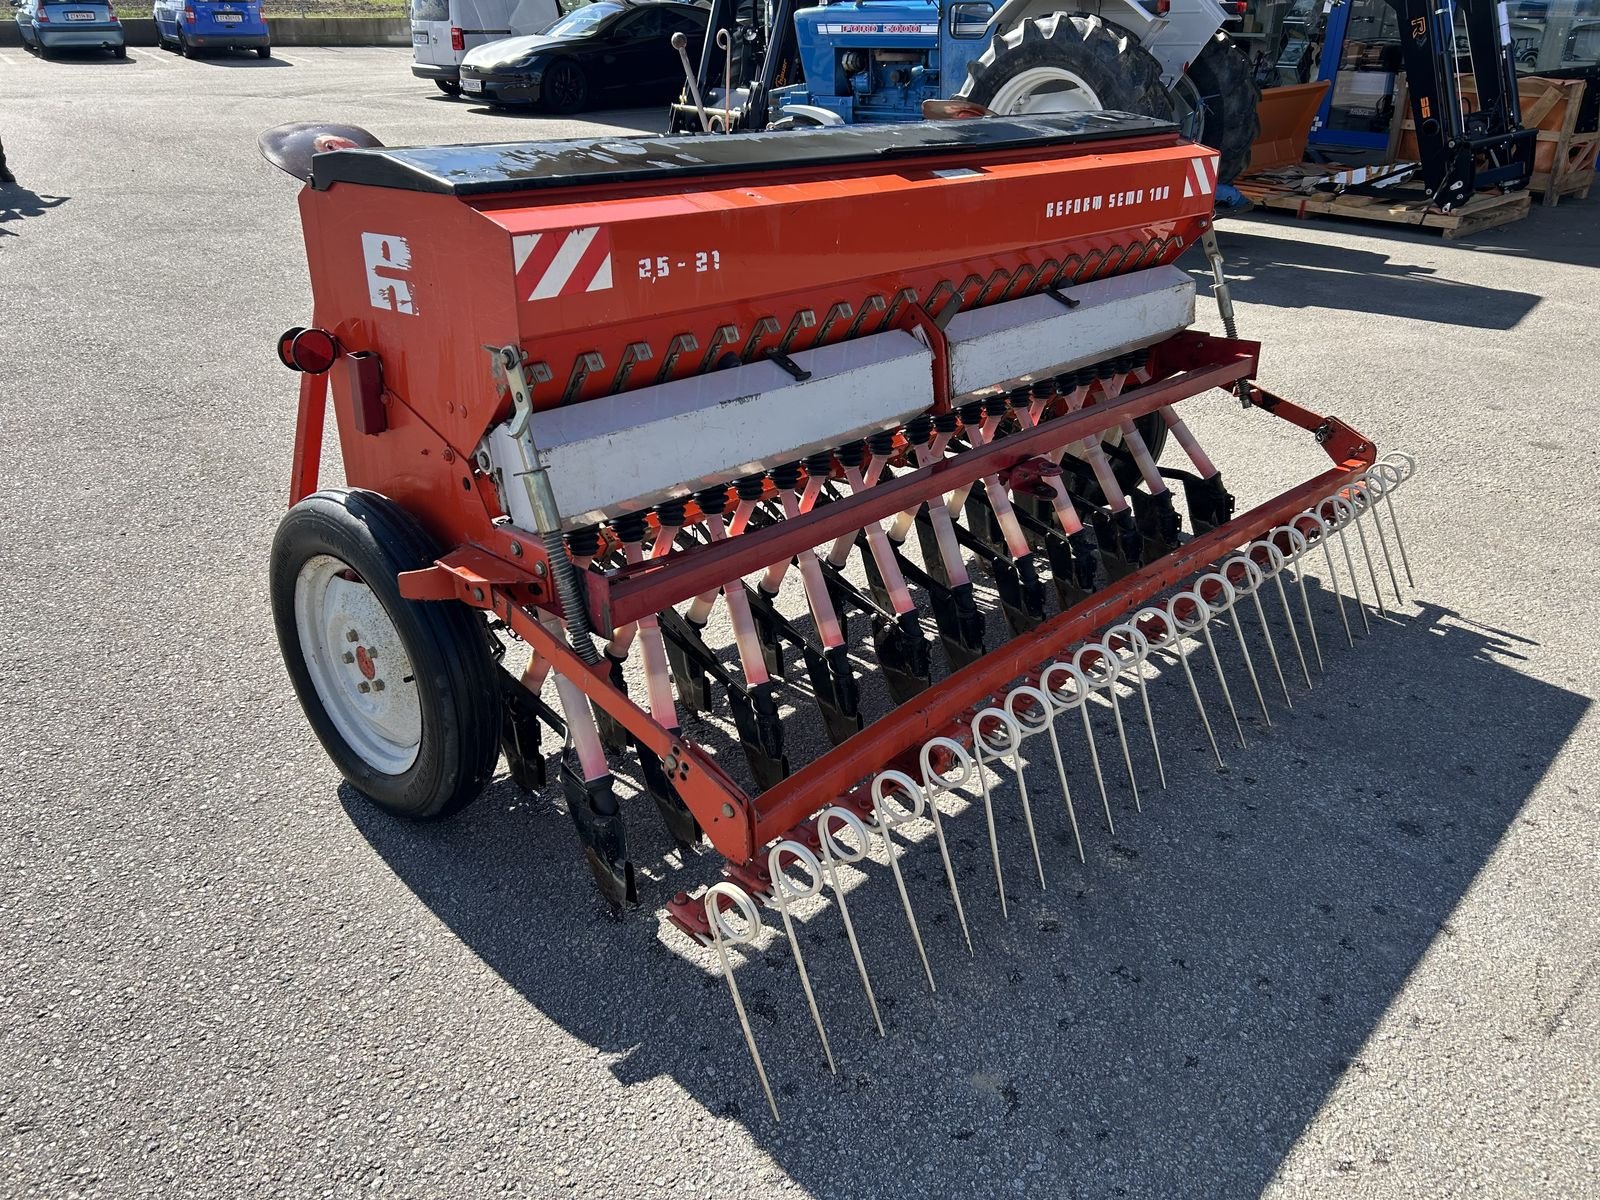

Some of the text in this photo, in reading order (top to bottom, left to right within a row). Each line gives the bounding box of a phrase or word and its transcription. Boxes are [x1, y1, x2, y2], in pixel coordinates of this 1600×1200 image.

[841, 25, 922, 33] FORD 5000
[1046, 185, 1169, 218] REFORM SEMO 100
[695, 249, 720, 273] 21
